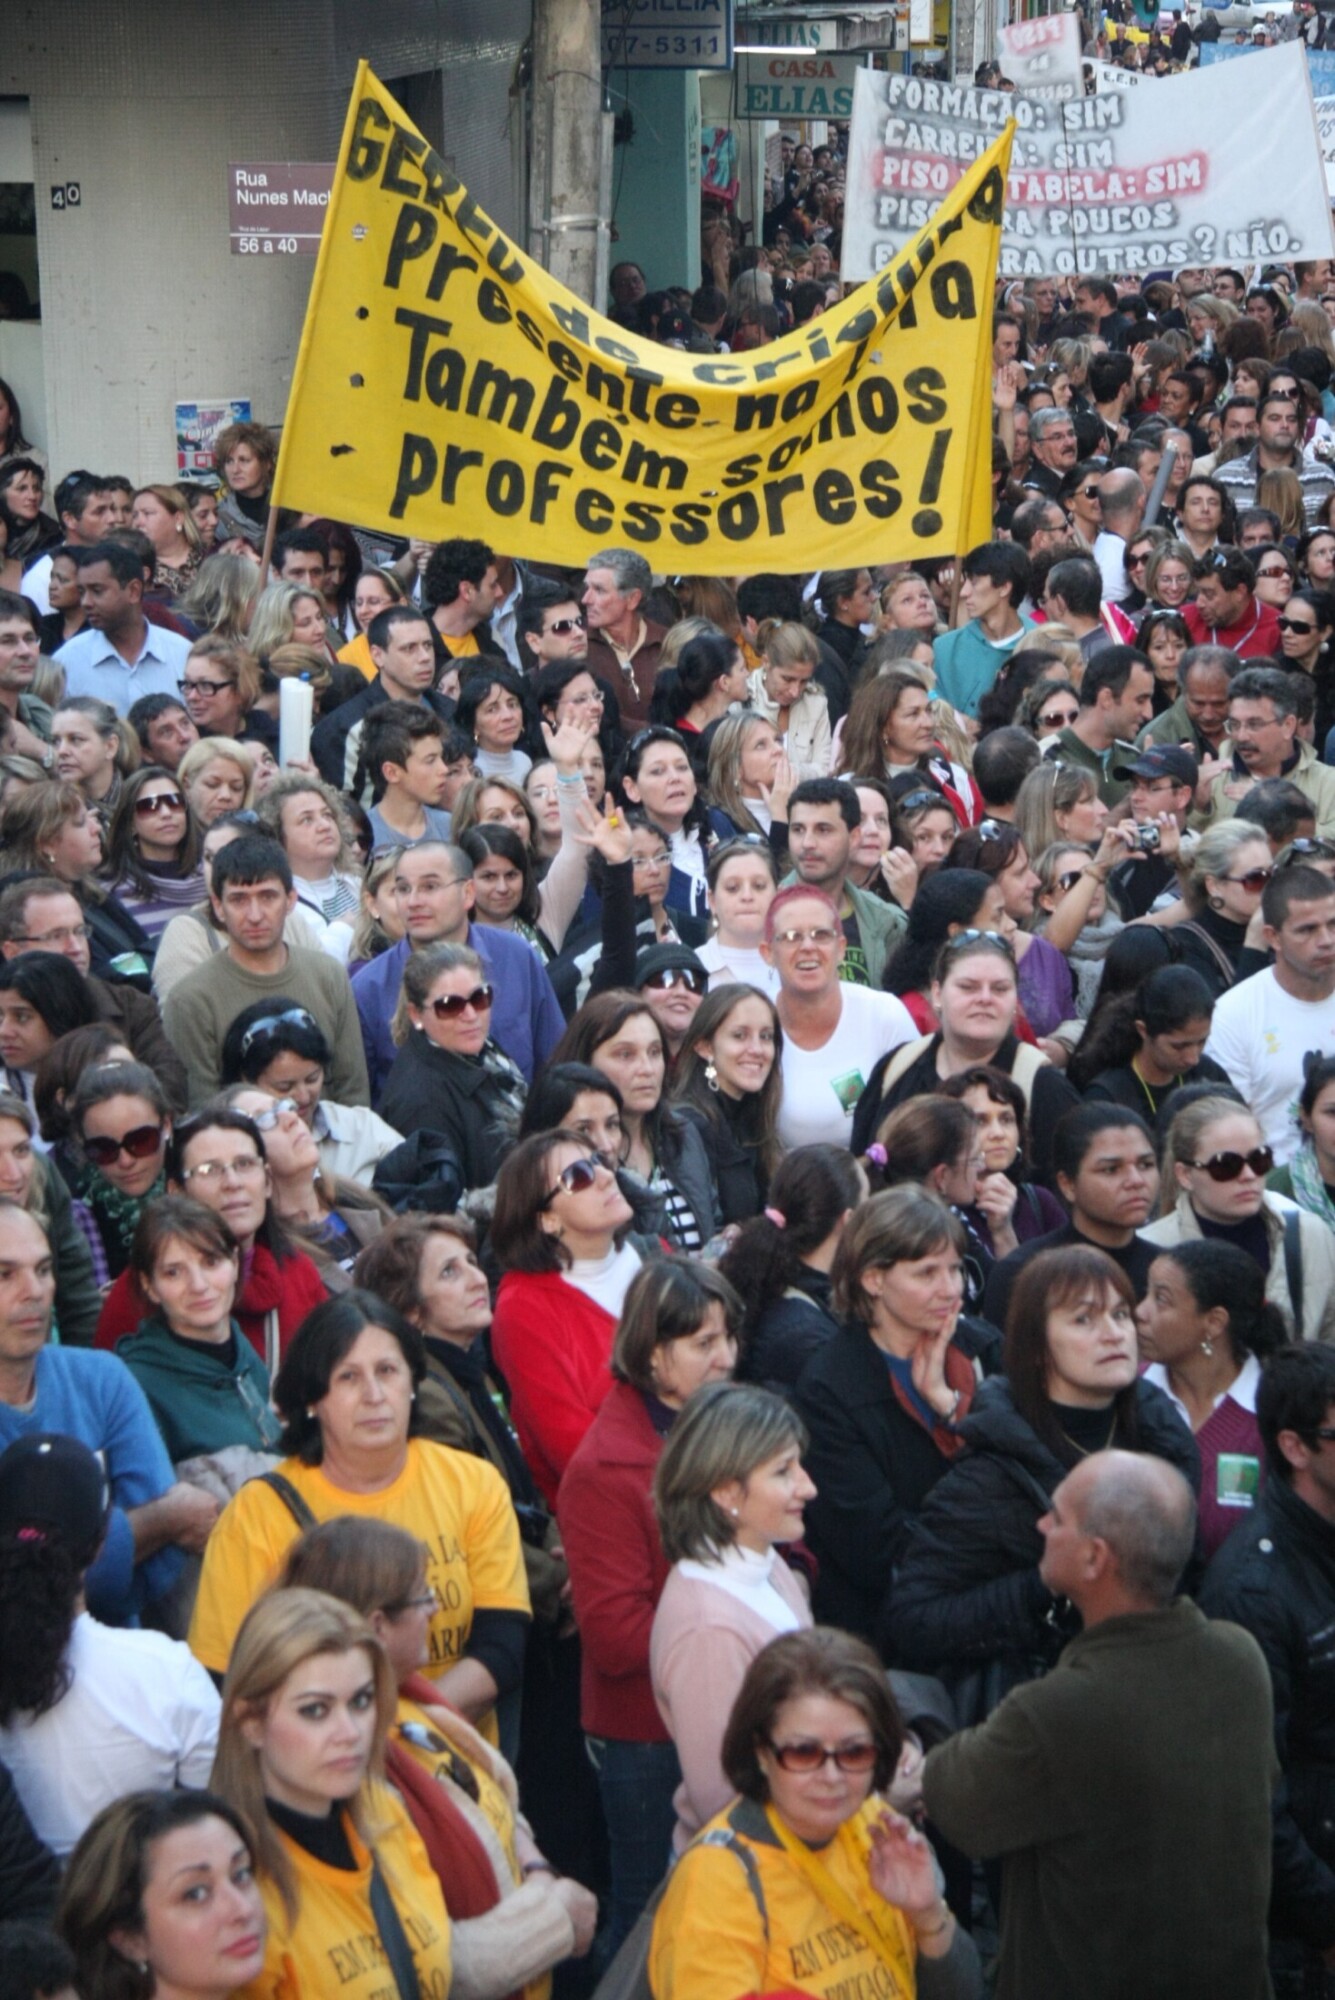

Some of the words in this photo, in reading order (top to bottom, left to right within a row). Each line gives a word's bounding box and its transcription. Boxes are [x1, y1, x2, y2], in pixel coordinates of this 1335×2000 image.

[600, 35, 720, 56] 07-5311
[768, 60, 836, 79] CASA
[744, 84, 855, 117] ELIAS
[1062, 94, 1121, 131] SIM
[885, 118, 1044, 167] CARREIA:
[1053, 138, 1114, 170] SIM
[235, 170, 268, 187] Rua
[882, 155, 950, 191] PISO
[1007, 171, 1137, 202] TABELA:
[1144, 157, 1202, 195] SIM
[52, 183, 80, 209] 40
[236, 189, 289, 205] Nunes
[1049, 201, 1173, 236] POUCOS
[239, 237, 259, 254] 56
[263, 240, 274, 254] a
[277, 237, 298, 254] 40
[1227, 219, 1302, 260] NÃO.
[382, 202, 701, 430] Presente
[733, 379, 820, 432] na
[394, 306, 689, 491] Também
[721, 366, 948, 488] somos
